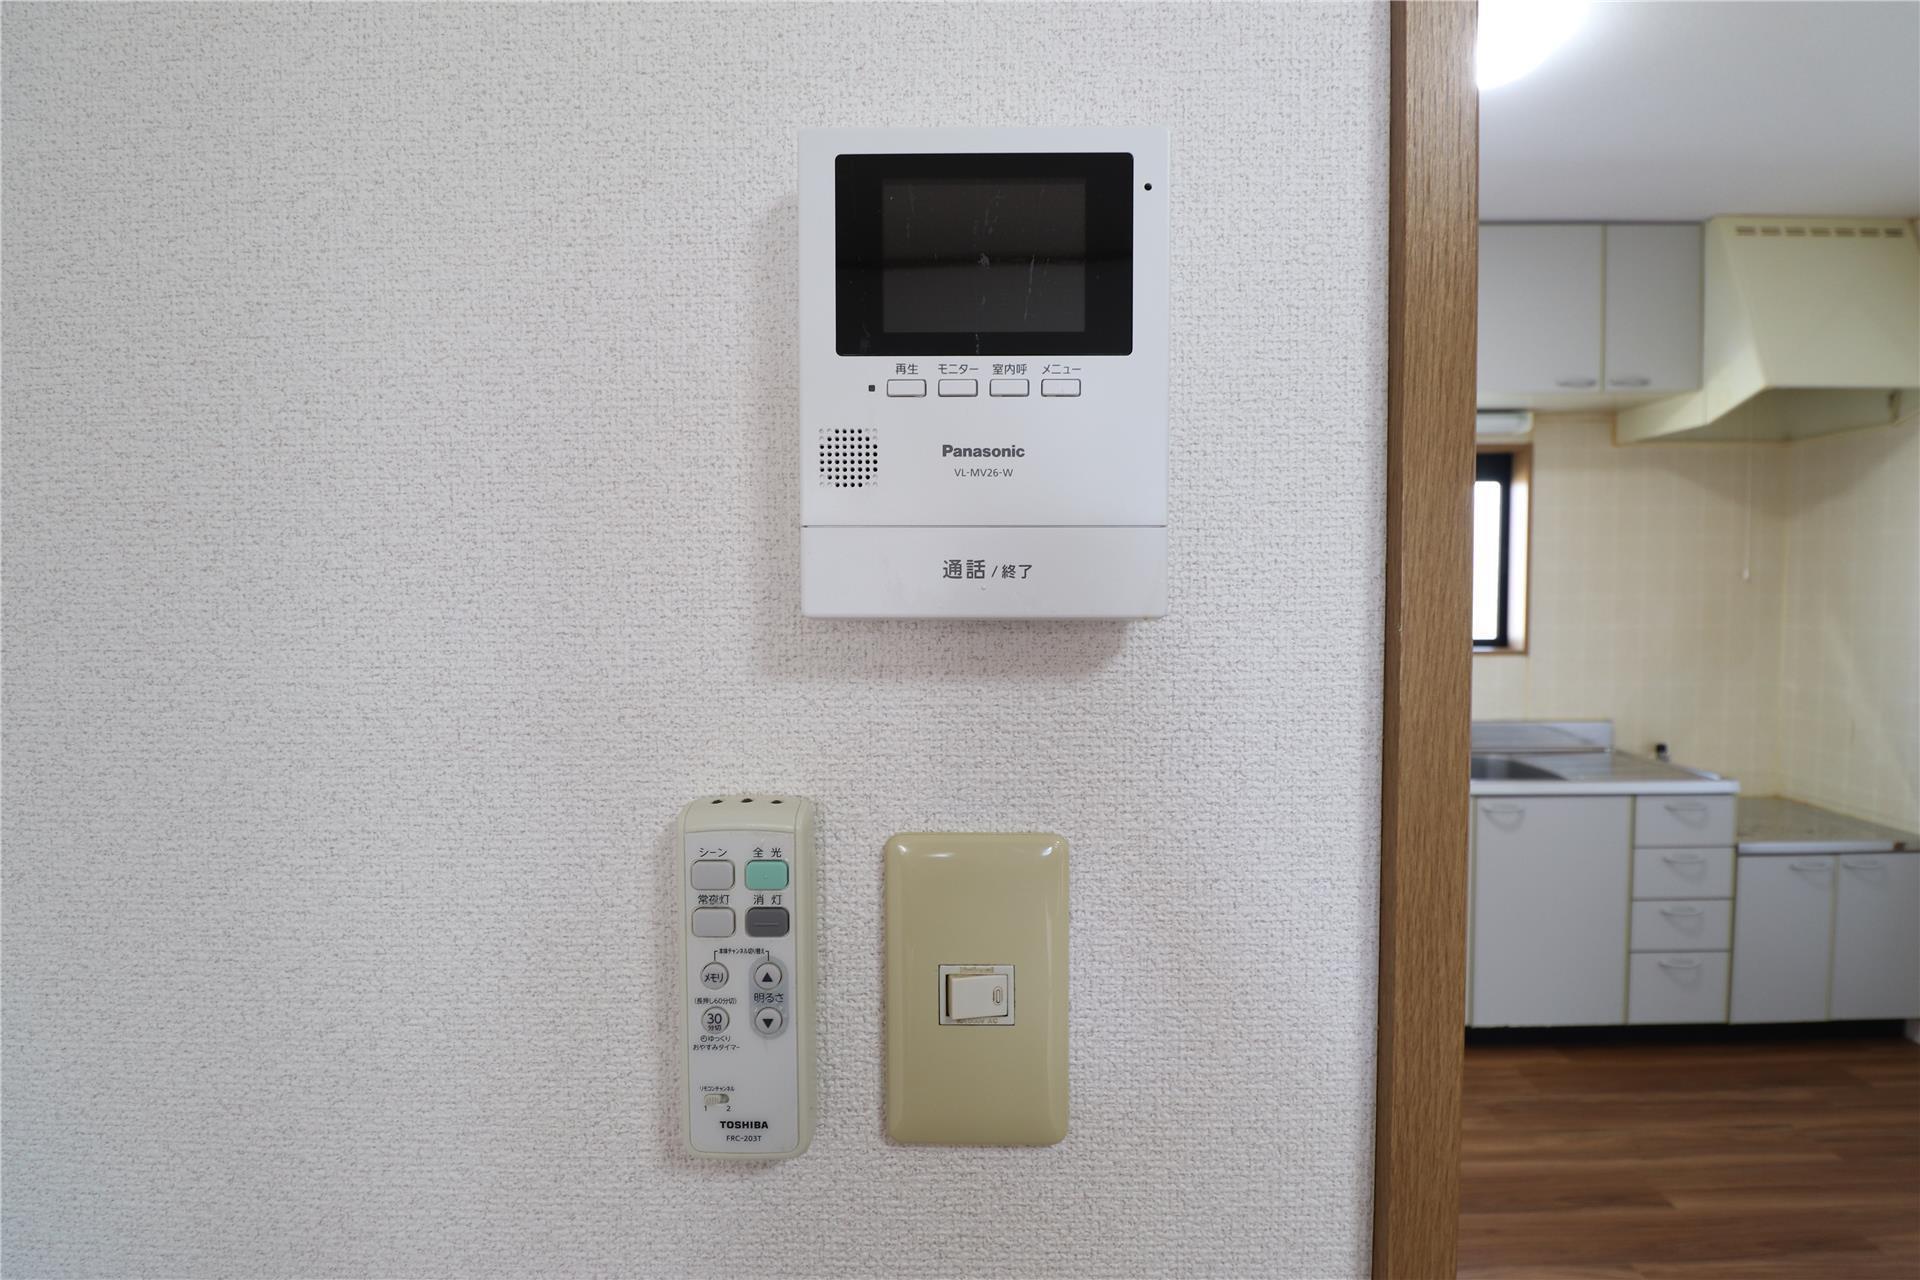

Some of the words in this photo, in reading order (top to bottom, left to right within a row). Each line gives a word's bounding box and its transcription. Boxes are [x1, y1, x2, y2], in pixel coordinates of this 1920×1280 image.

[895, 363, 919, 375] 再生
[937, 364, 980, 375] モニター
[992, 363, 1028, 375] 室内呼
[1042, 364, 1082, 375] メニュー
[941, 444, 1025, 458] Panasonic
[953, 467, 1014, 478] VL-MV26-W
[699, 847, 728, 858] シーン
[697, 894, 730, 905] 常夜灯
[704, 973, 724, 983] メモリ
[753, 992, 784, 1004] 明るさ
[706, 1013, 723, 1025] 30
[720, 1121, 769, 1129] TOSHIBA
